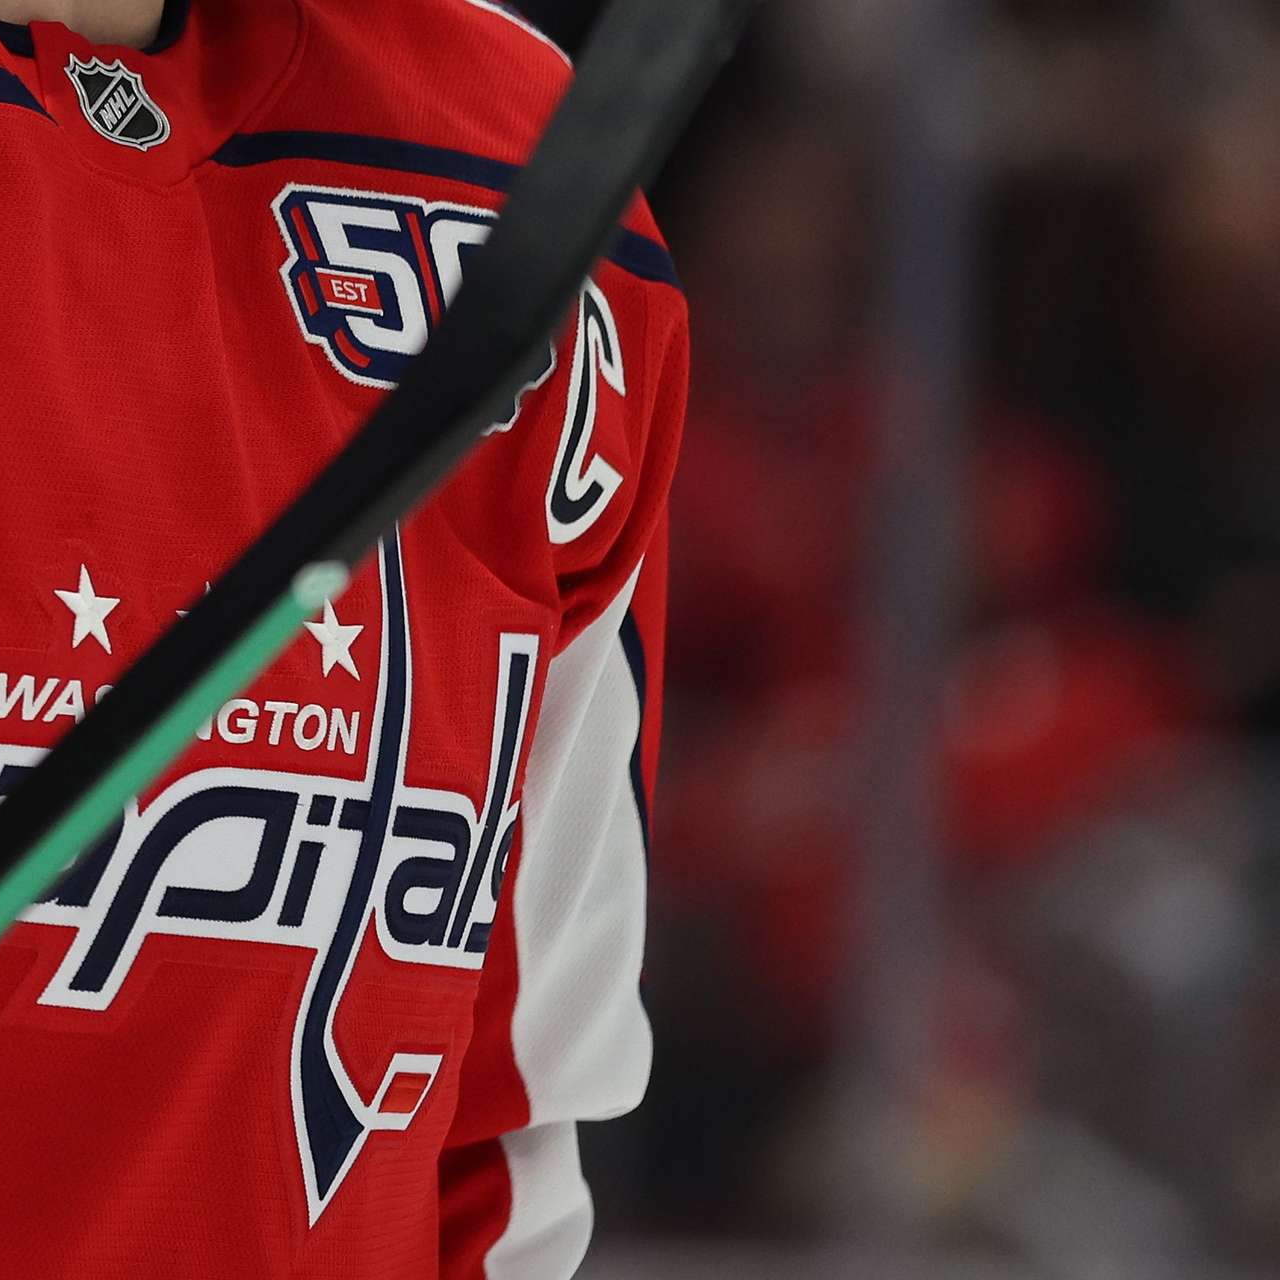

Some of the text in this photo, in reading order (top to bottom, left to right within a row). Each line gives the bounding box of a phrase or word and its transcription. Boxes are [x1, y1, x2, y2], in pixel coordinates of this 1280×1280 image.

[99, 84, 136, 131] NHL
[330, 279, 368, 303] EST
[546, 275, 626, 545] C
